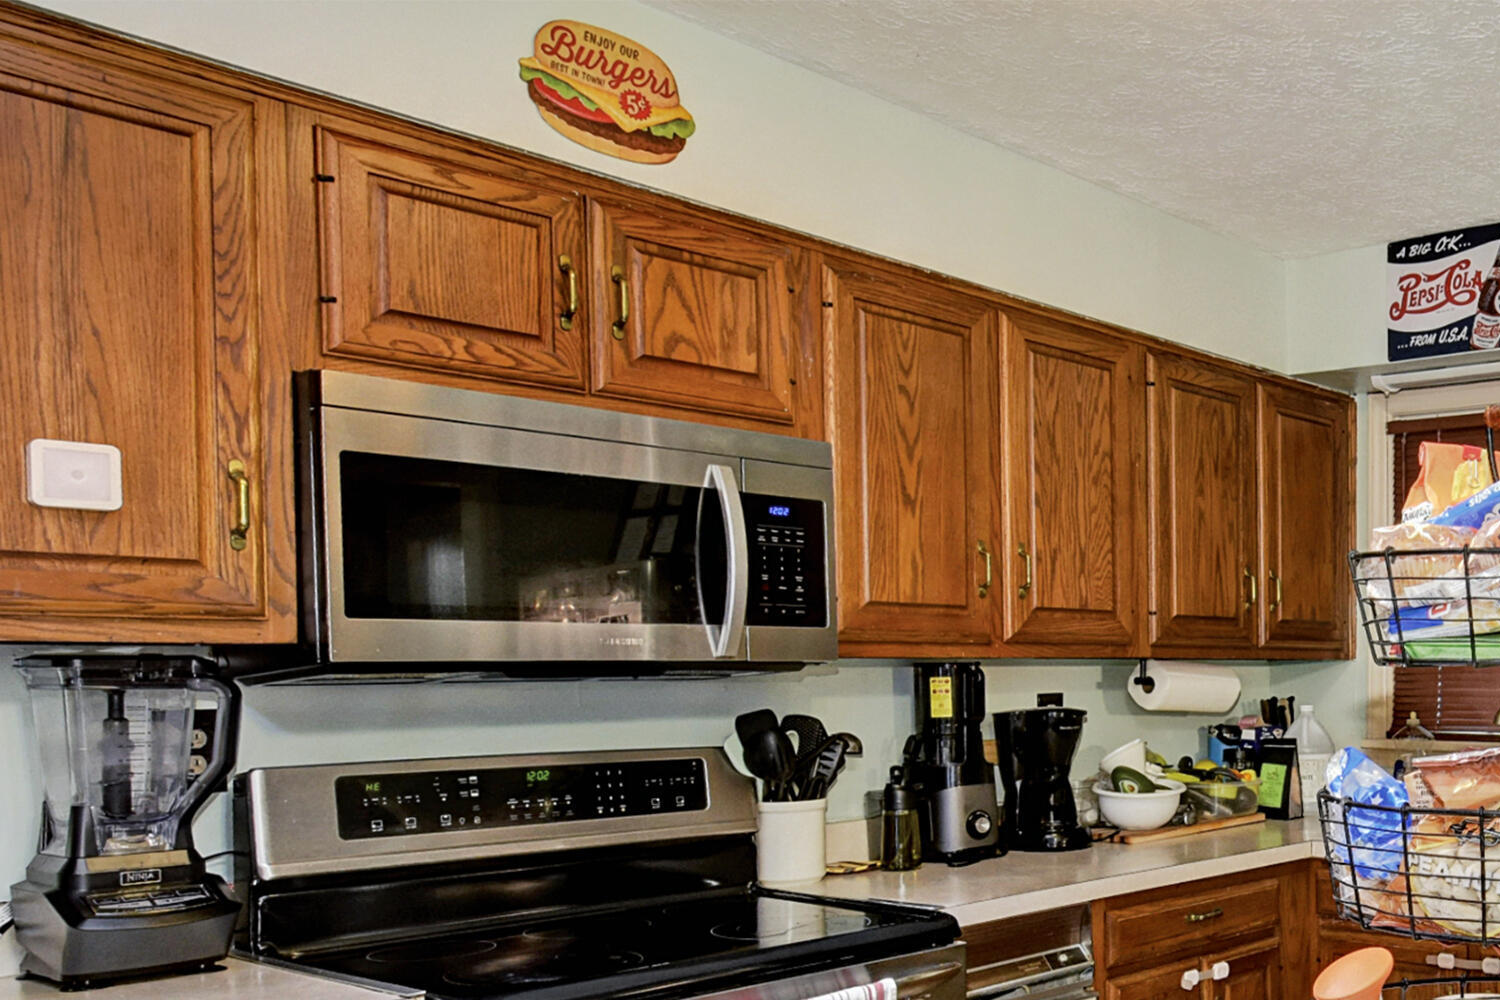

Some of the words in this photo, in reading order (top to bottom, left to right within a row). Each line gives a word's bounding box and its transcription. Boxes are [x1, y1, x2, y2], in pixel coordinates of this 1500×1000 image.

[583, 30, 616, 52] ENJOY
[619, 44, 640, 61] OUR
[541, 25, 676, 98] Burgers
[550, 61, 568, 74] BEST
[571, 68, 579, 77] IN
[627, 95, 647, 116] 5¢
[1396, 247, 1406, 259] A
[1409, 243, 1432, 257] BIG
[1438, 326, 1469, 344] U.S.A.
[126, 872, 154, 882] NINJA
